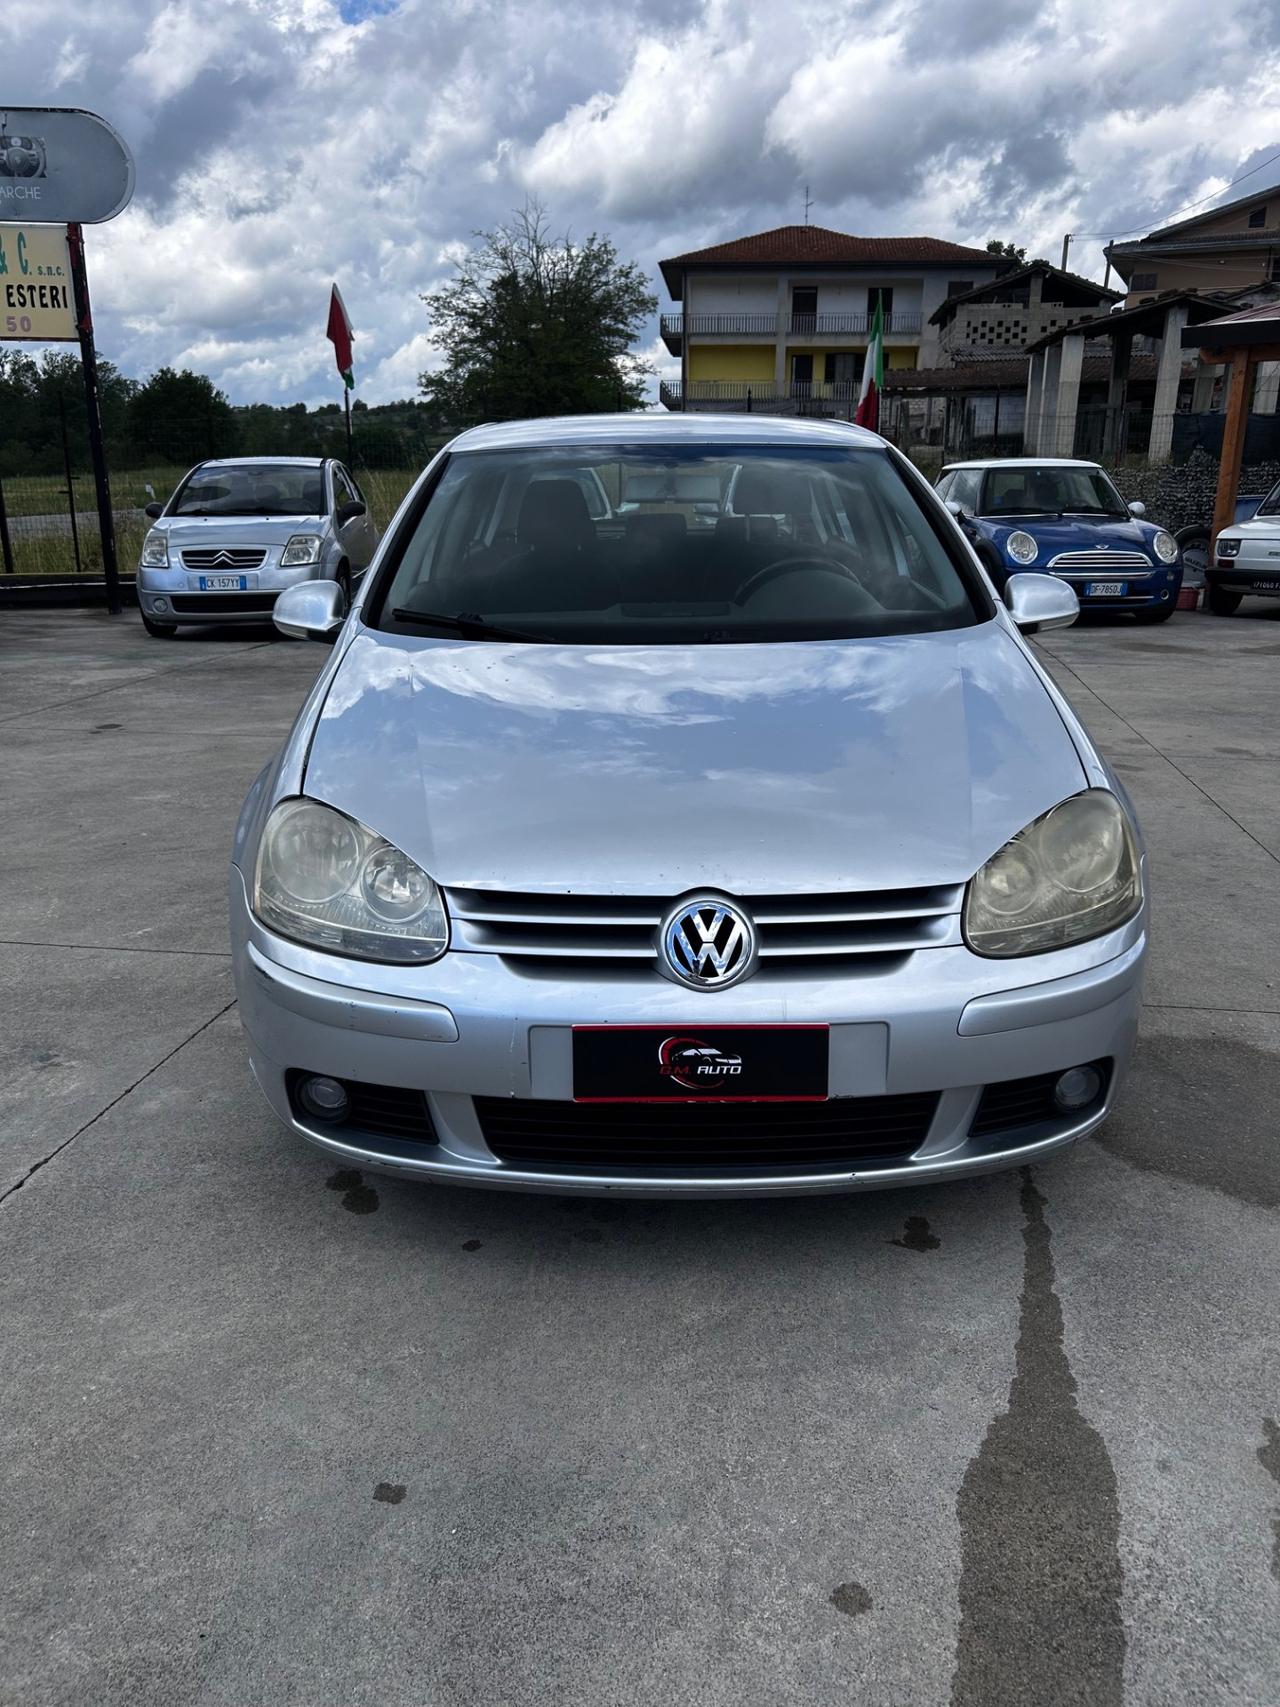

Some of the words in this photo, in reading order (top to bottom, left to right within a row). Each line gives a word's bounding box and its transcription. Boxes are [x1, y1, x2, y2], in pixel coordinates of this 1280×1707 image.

[37, 265, 65, 276] s.n.c.
[6, 284, 68, 308] ESTERI
[6, 316, 32, 332] 50
[697, 1065, 742, 1075] AUTO
